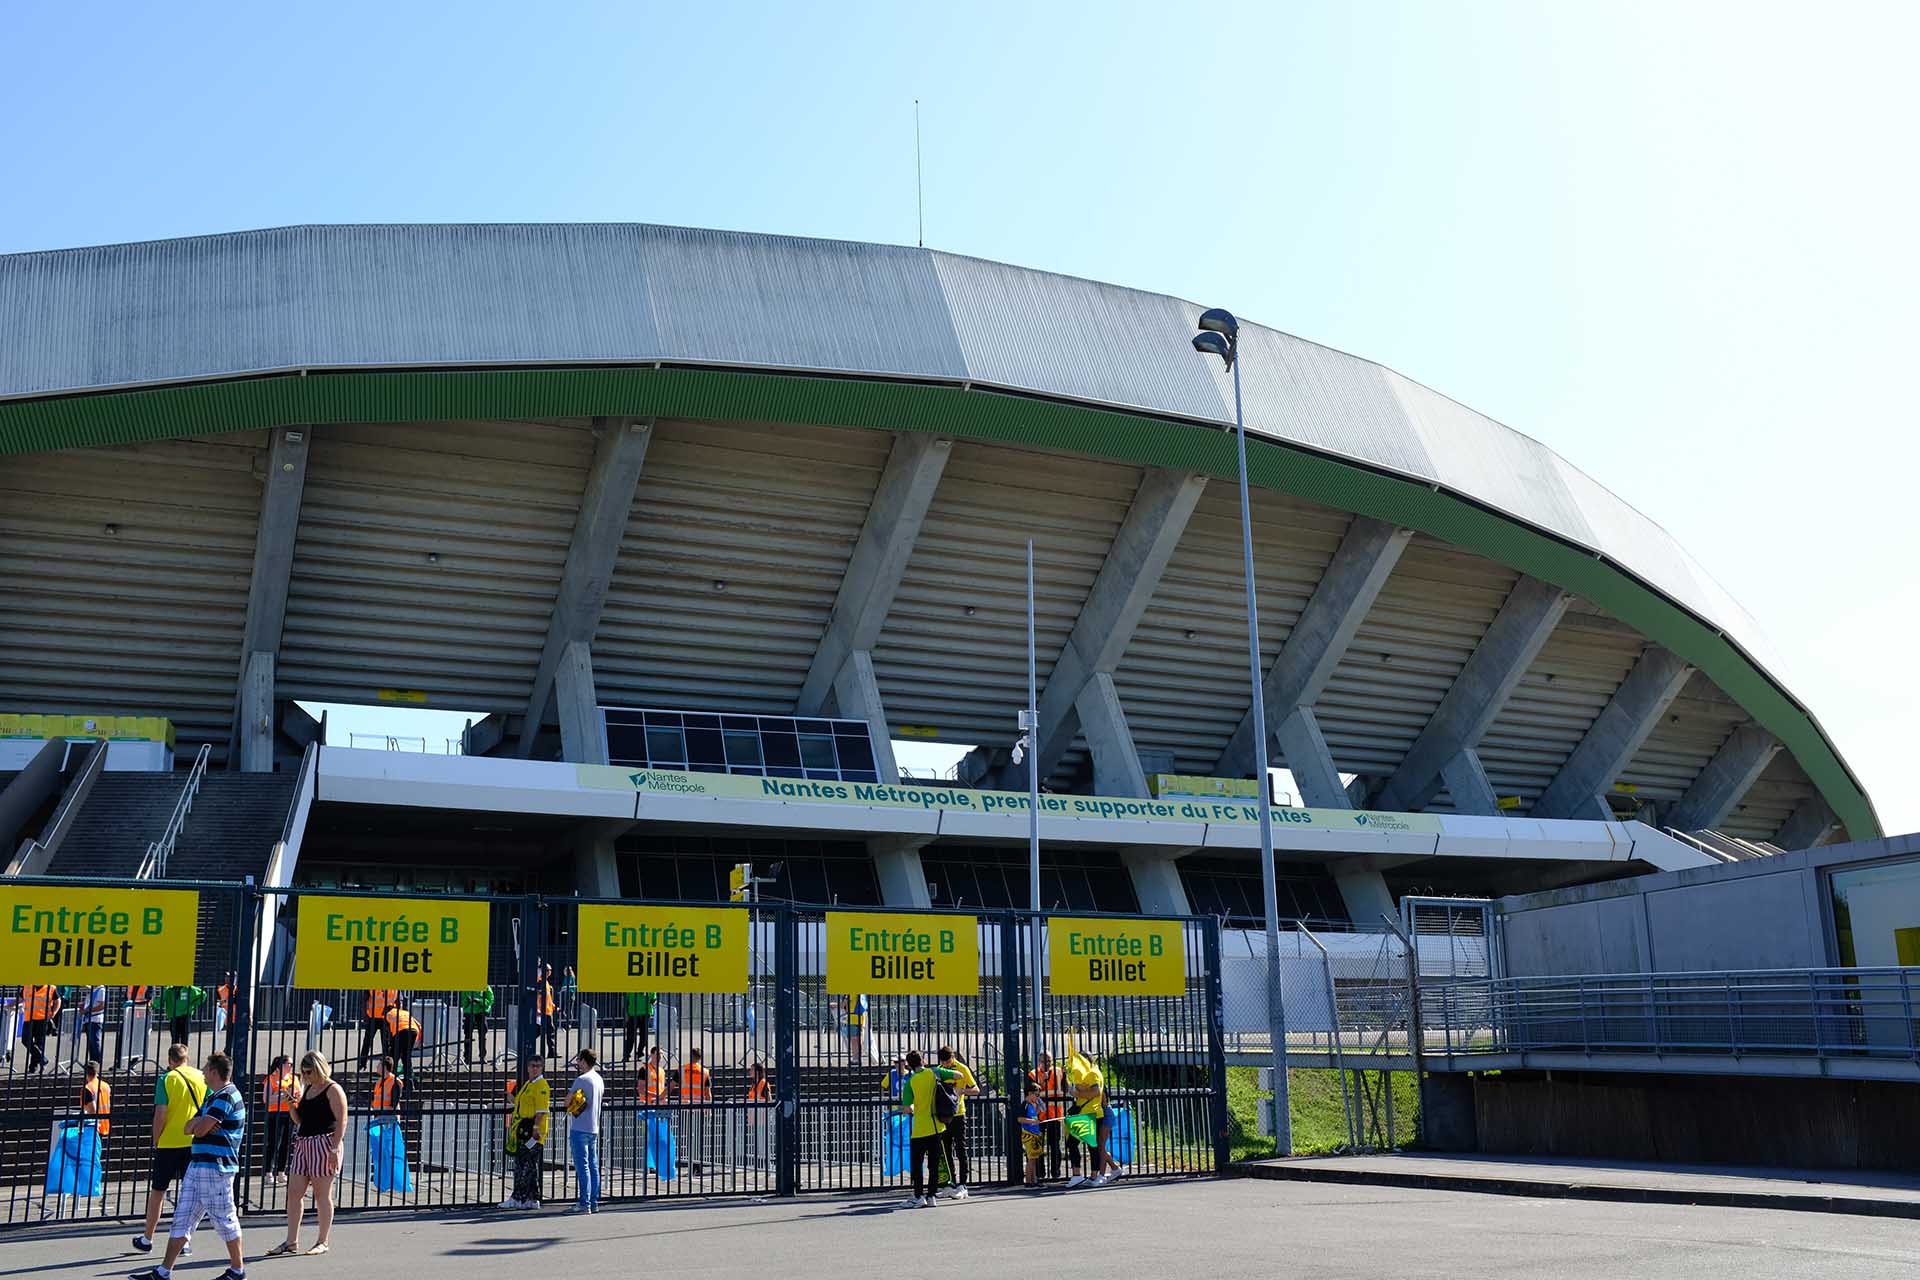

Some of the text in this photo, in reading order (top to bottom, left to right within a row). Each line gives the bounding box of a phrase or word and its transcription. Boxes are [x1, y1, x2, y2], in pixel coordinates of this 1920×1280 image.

[646, 771, 688, 784] Nantes
[761, 778, 849, 800] Nantes
[854, 783, 977, 810] Métropole,
[1073, 799, 1175, 820] supporter
[1181, 803, 1209, 820] du
[1212, 806, 1238, 821] FC
[1242, 806, 1312, 825] Nntes
[12, 904, 164, 936] Entrée B
[326, 913, 459, 944] Entrée B
[604, 921, 722, 949] Entrée B
[850, 927, 955, 954] Entrée B
[1069, 932, 1163, 957] Entrée B
[40, 938, 133, 968] Billet
[351, 945, 433, 974] Billet
[627, 951, 700, 977] Billet
[871, 955, 936, 980] Billet
[1089, 958, 1147, 982] Billet
